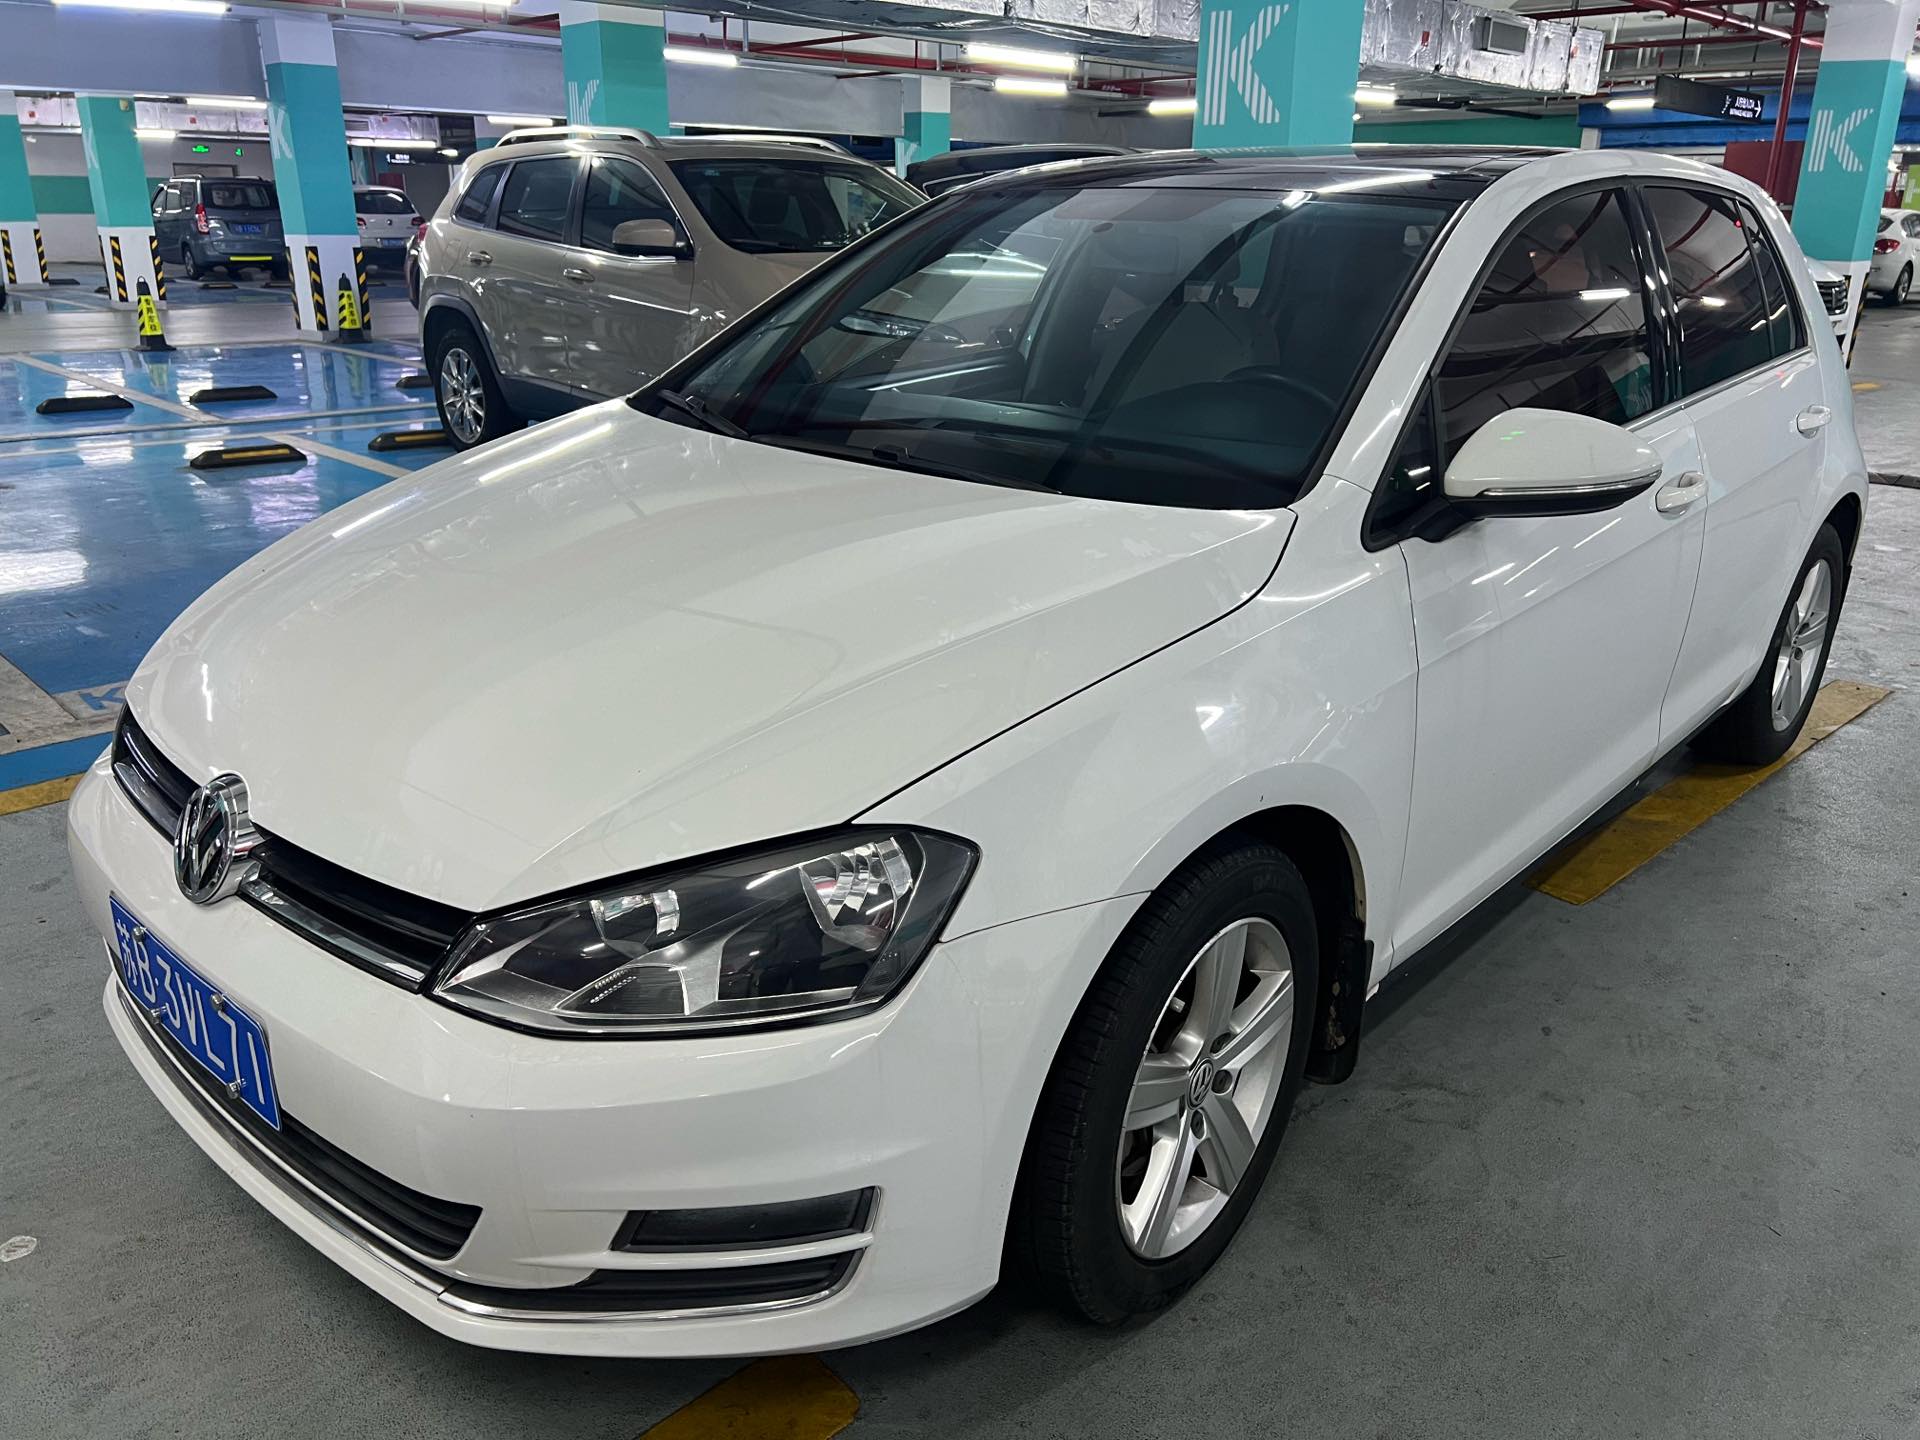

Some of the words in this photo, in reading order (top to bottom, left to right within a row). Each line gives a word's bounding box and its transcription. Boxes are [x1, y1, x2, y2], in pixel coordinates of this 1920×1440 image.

[1204, 4, 1289, 126] K
[268, 106, 293, 160] K
[1807, 108, 1874, 172] K
